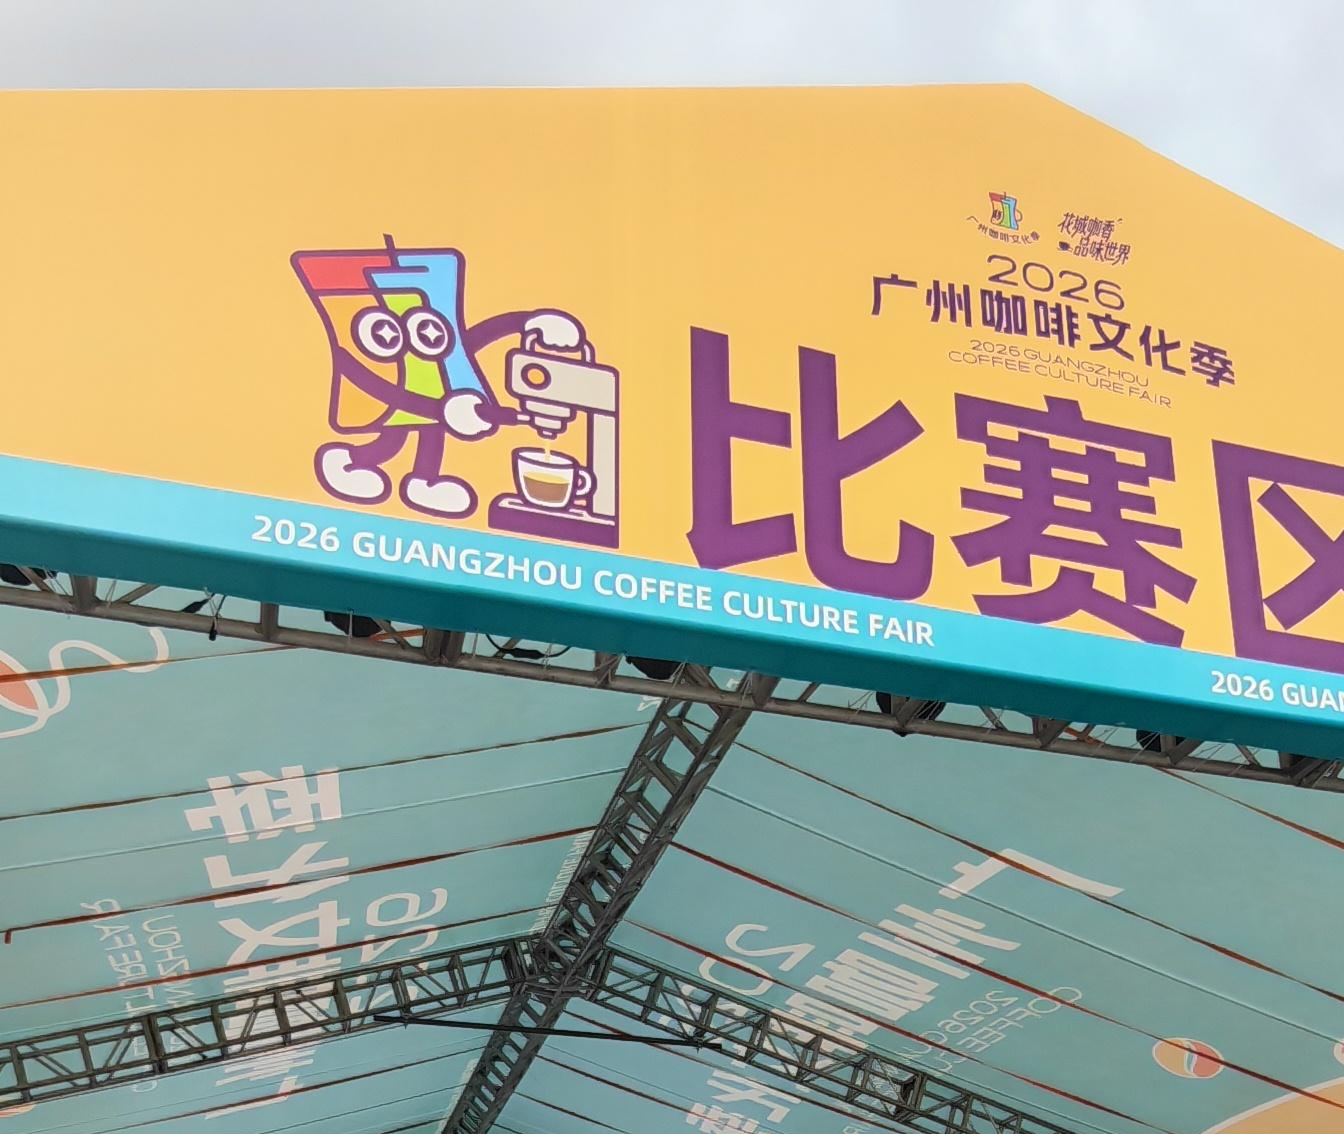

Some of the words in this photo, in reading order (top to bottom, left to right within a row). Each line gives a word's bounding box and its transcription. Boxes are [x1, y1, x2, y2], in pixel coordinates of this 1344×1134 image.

[1073, 236, 1131, 266] 品味世界
[986, 254, 1125, 311] 2026
[871, 273, 1236, 387] 广州咖啡文化季
[948, 351, 1031, 373] COFFEE
[1034, 363, 1126, 397] CULTURE
[1128, 385, 1172, 408] FAIR
[969, 339, 1020, 358] 2026
[1024, 349, 1149, 387] GUANGZHOU
[250, 514, 341, 553] 2026
[352, 529, 584, 591] GUANGZHOU
[593, 568, 713, 612] COFFEE
[722, 588, 861, 636] CULTURE
[868, 611, 935, 648] FAIR
[1210, 669, 1275, 702] 2026
